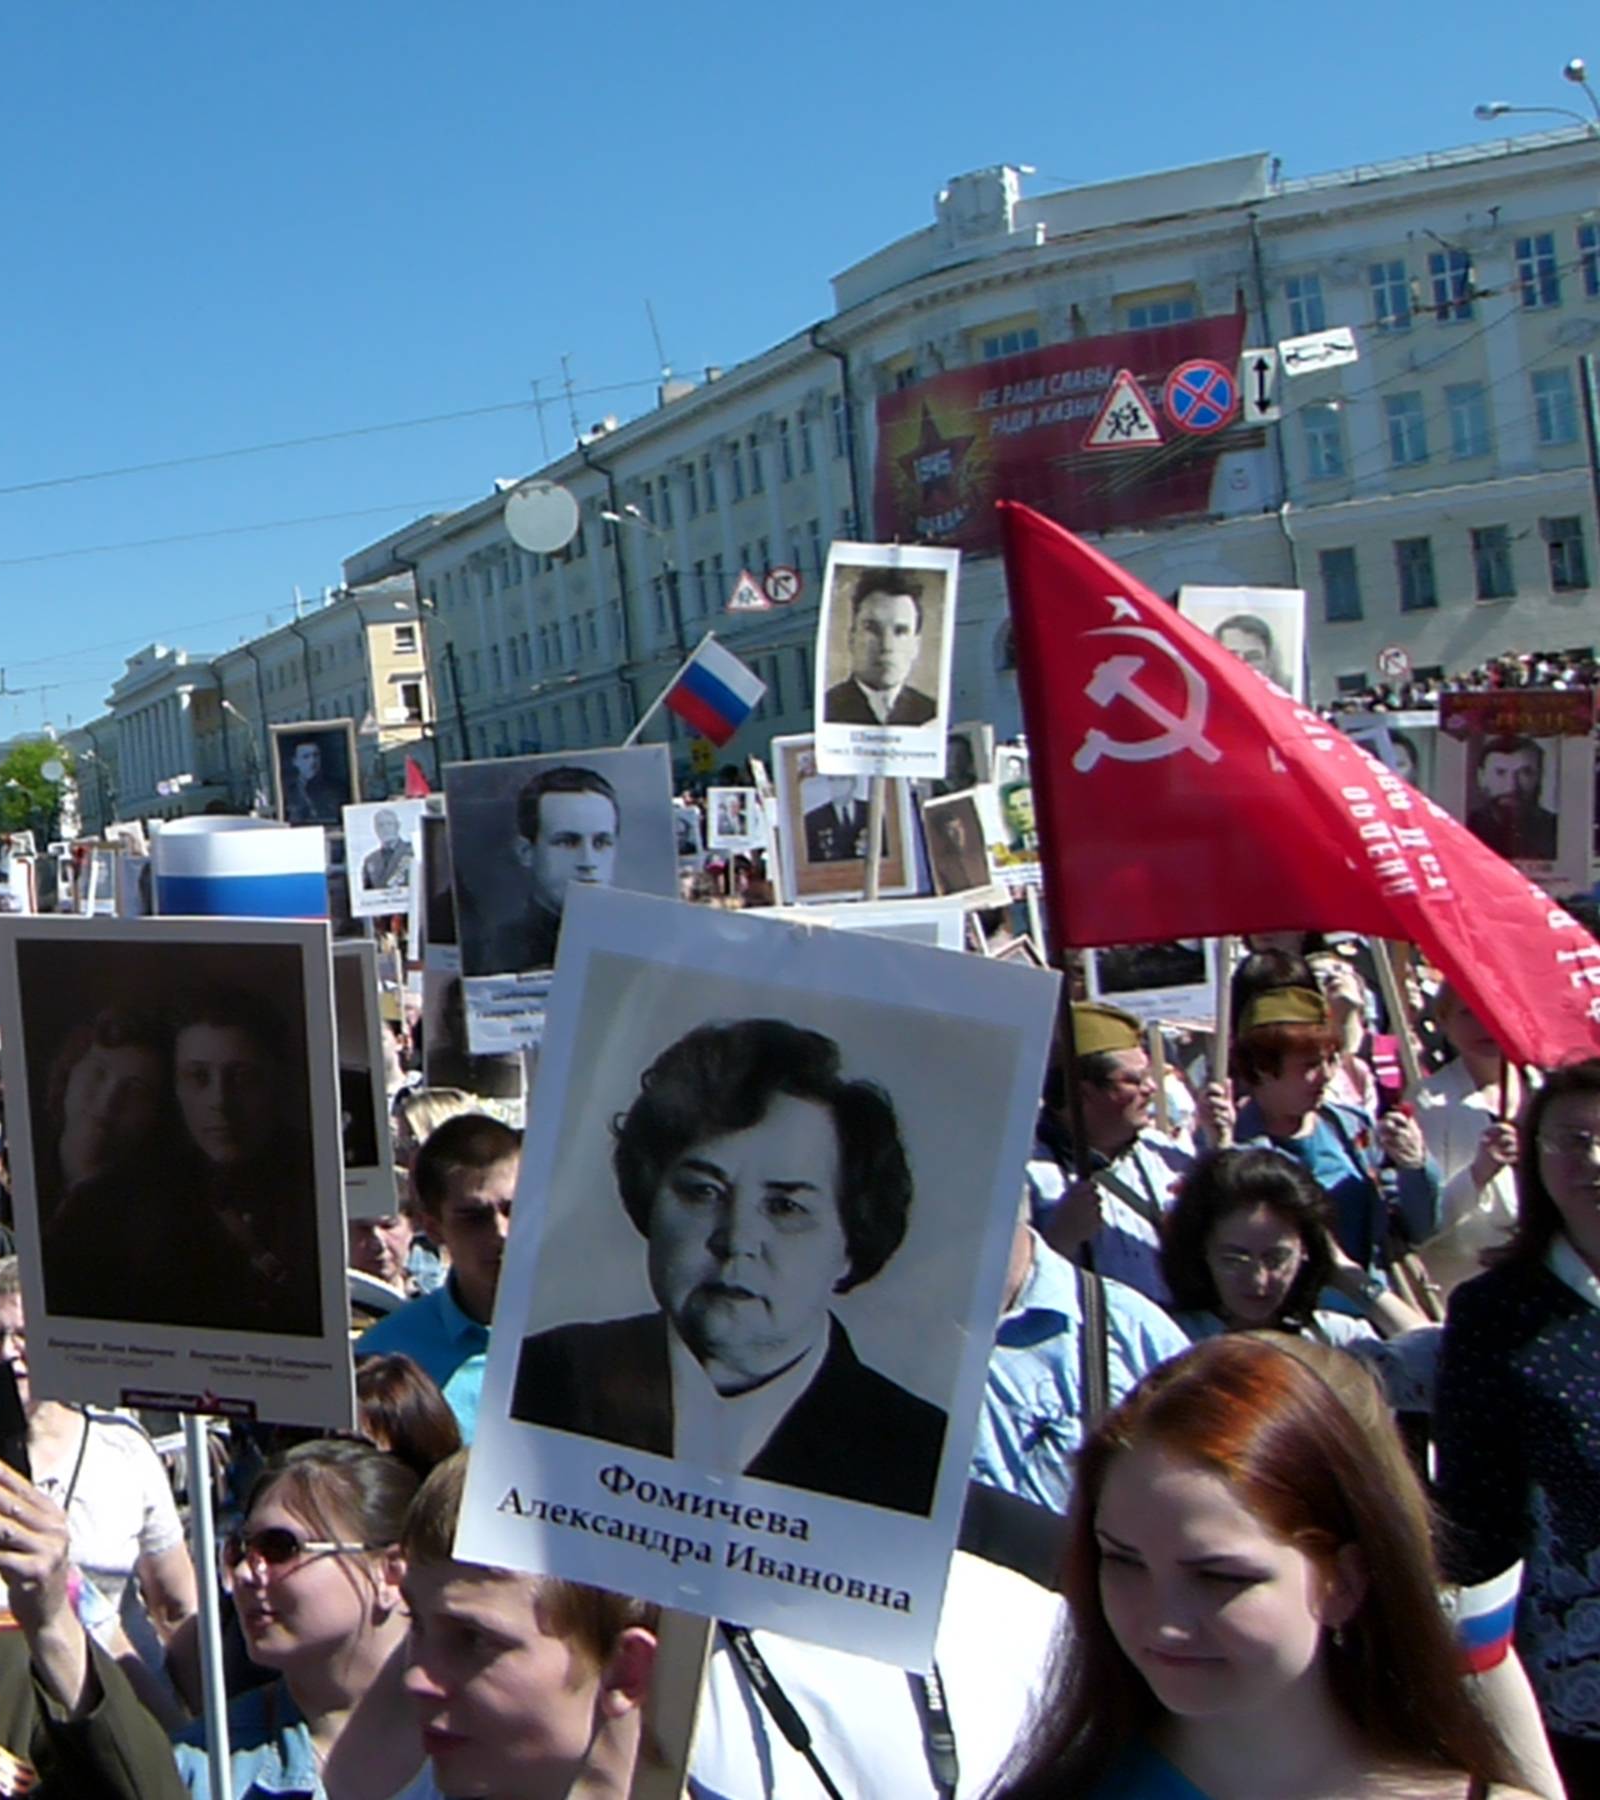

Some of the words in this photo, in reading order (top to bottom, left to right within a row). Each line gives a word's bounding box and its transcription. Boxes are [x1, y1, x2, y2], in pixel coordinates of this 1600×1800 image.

[1003, 377, 1045, 404] РАДИ
[989, 411, 1033, 438] РАДИ
[598, 1462, 812, 1542] Фомичева
[497, 1486, 712, 1565] Александра
[723, 1540, 914, 1614] Ивановна
